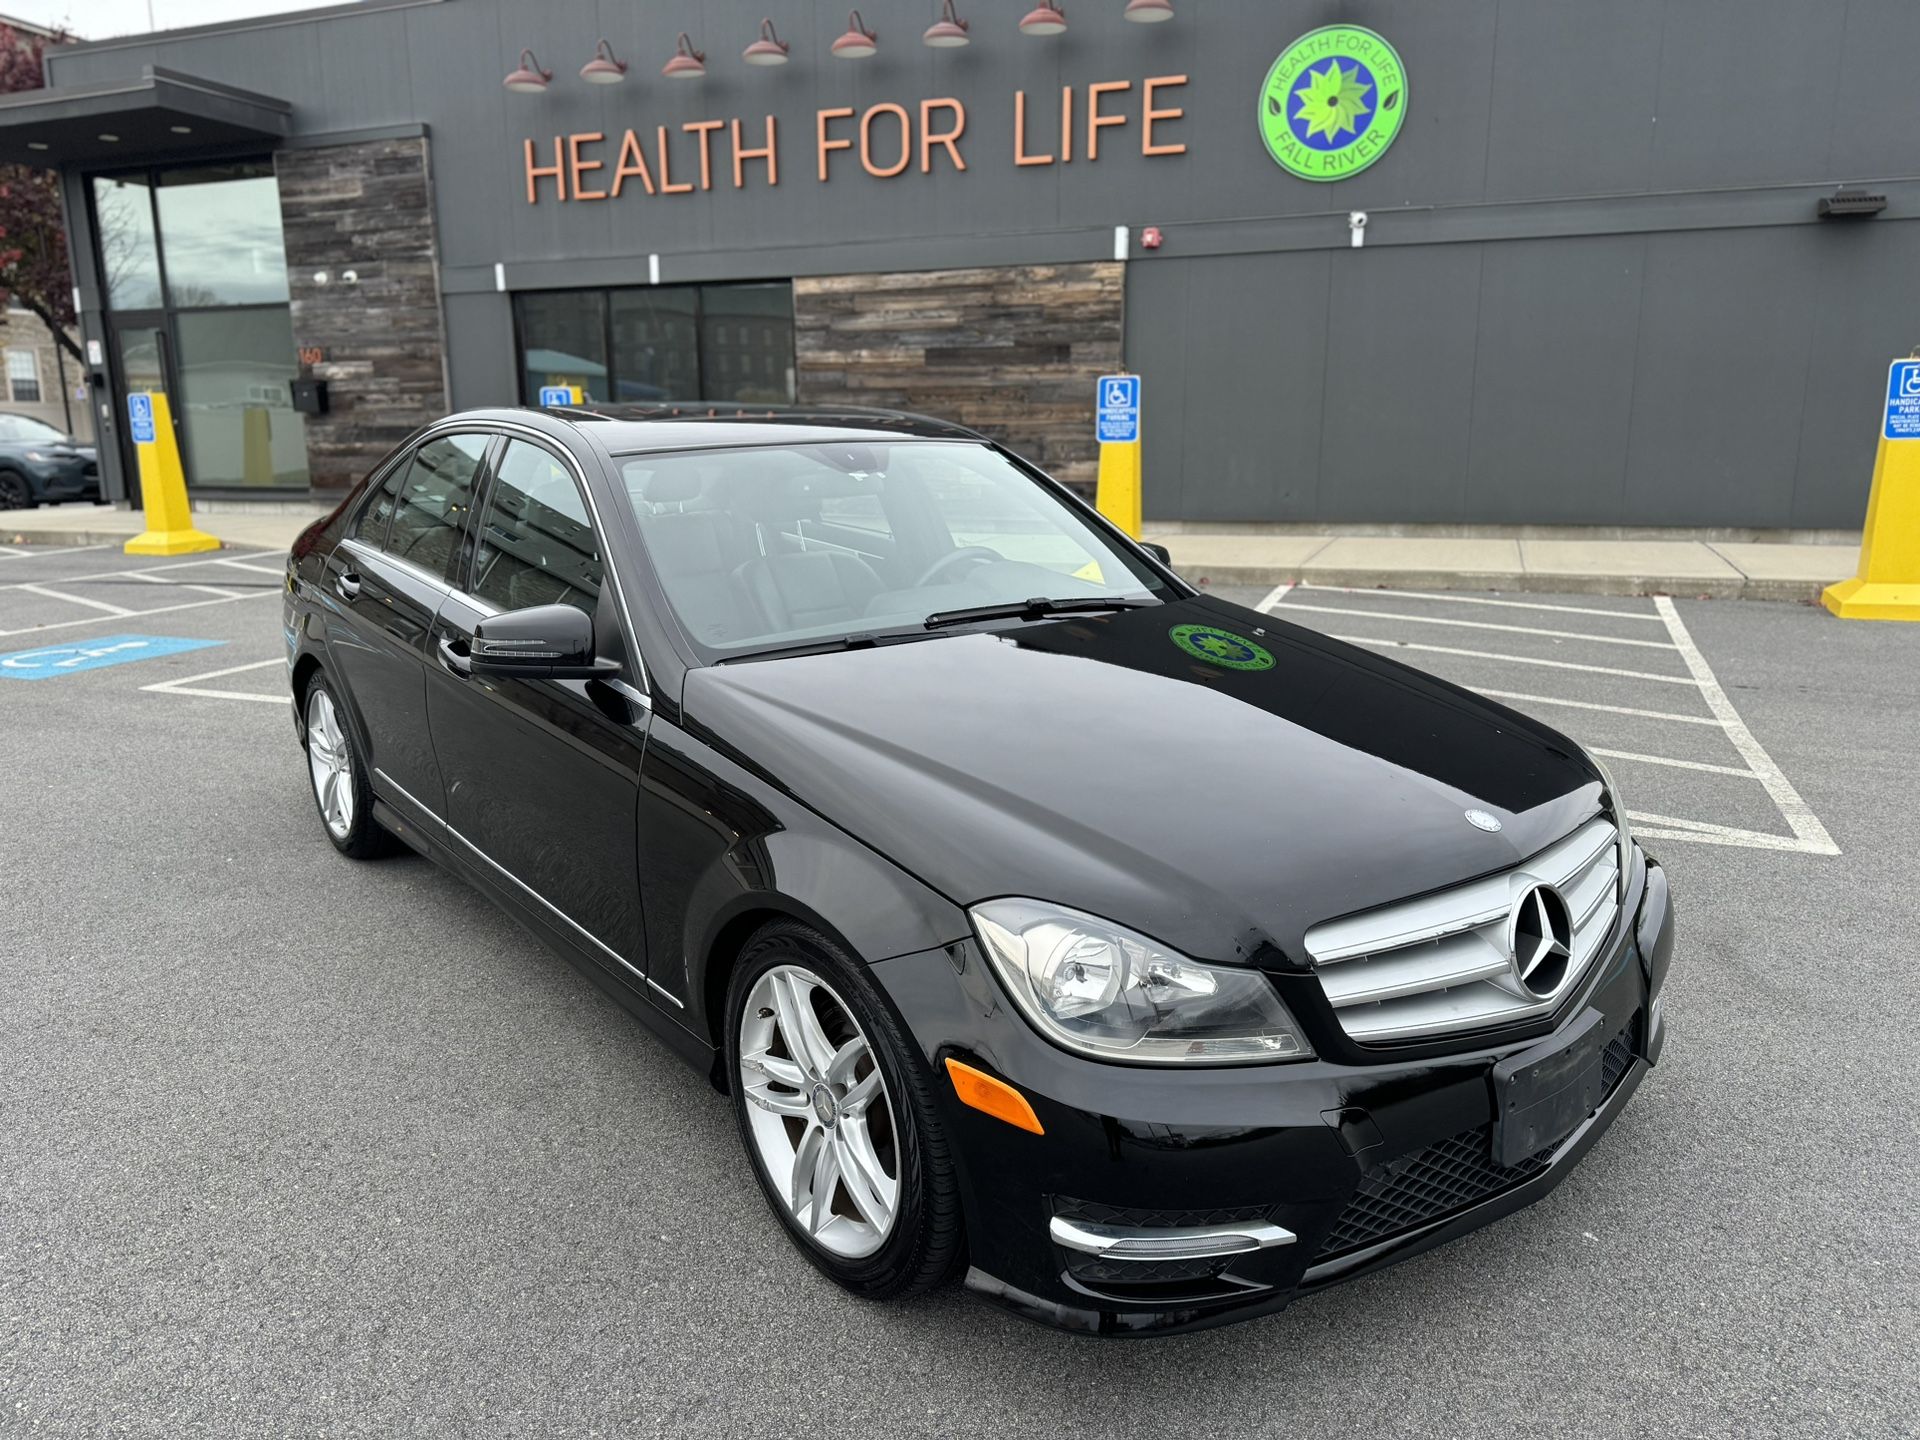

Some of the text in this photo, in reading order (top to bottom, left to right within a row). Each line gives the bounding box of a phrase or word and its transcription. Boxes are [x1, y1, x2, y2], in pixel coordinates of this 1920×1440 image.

[1272, 33, 1398, 92] HEALTH FOR LIFE
[523, 74, 1188, 204] HEALTH FOR LIFE
[1275, 128, 1386, 172] FALL RIVER
[298, 347, 322, 365] 160
